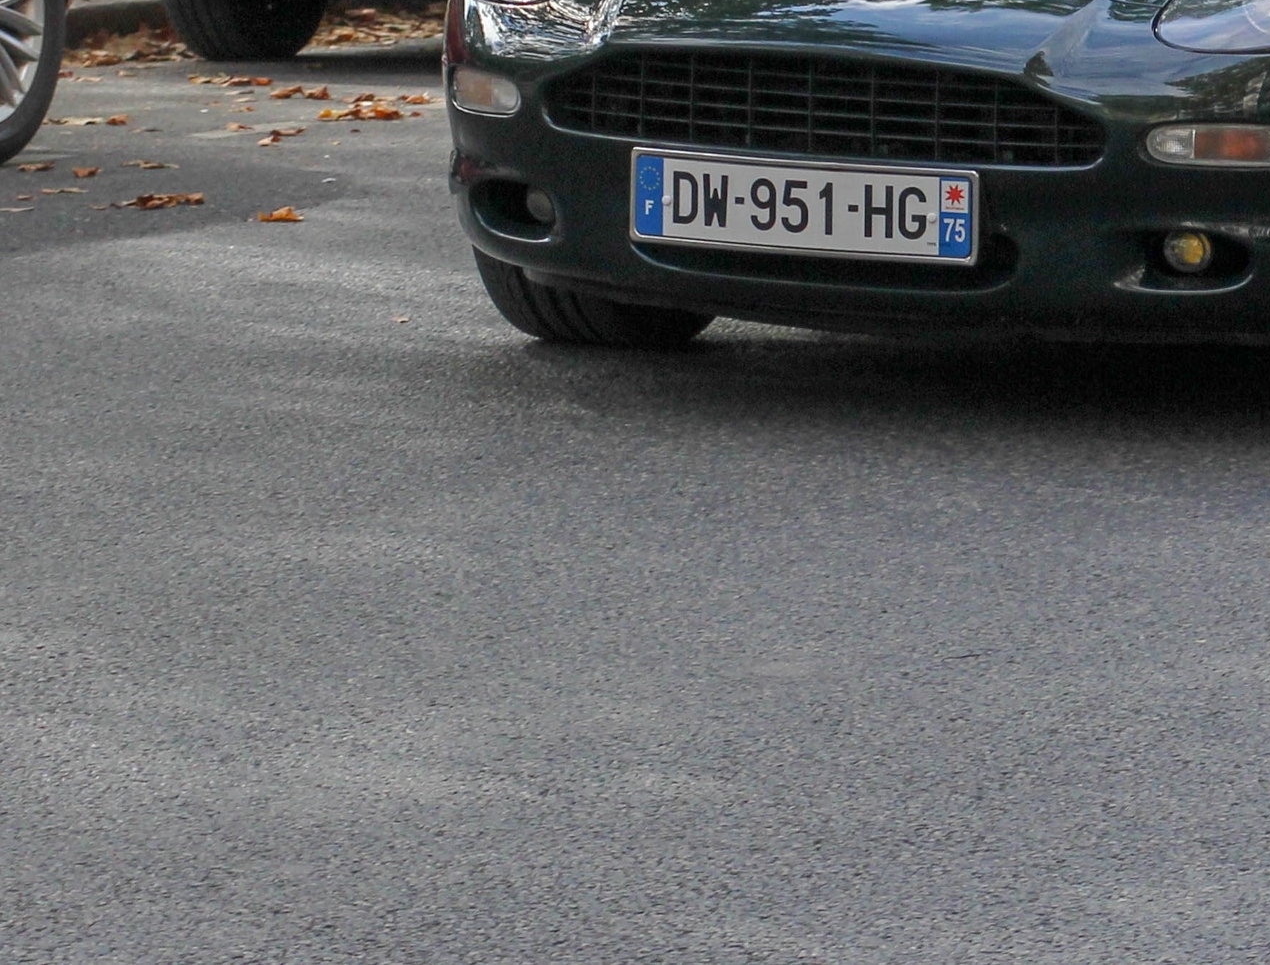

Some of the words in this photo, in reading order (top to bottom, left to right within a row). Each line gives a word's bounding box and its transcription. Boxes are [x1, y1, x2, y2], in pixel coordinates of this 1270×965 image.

[644, 199, 654, 215] F
[672, 171, 927, 240] DW-951-HG
[943, 218, 966, 242] 75
